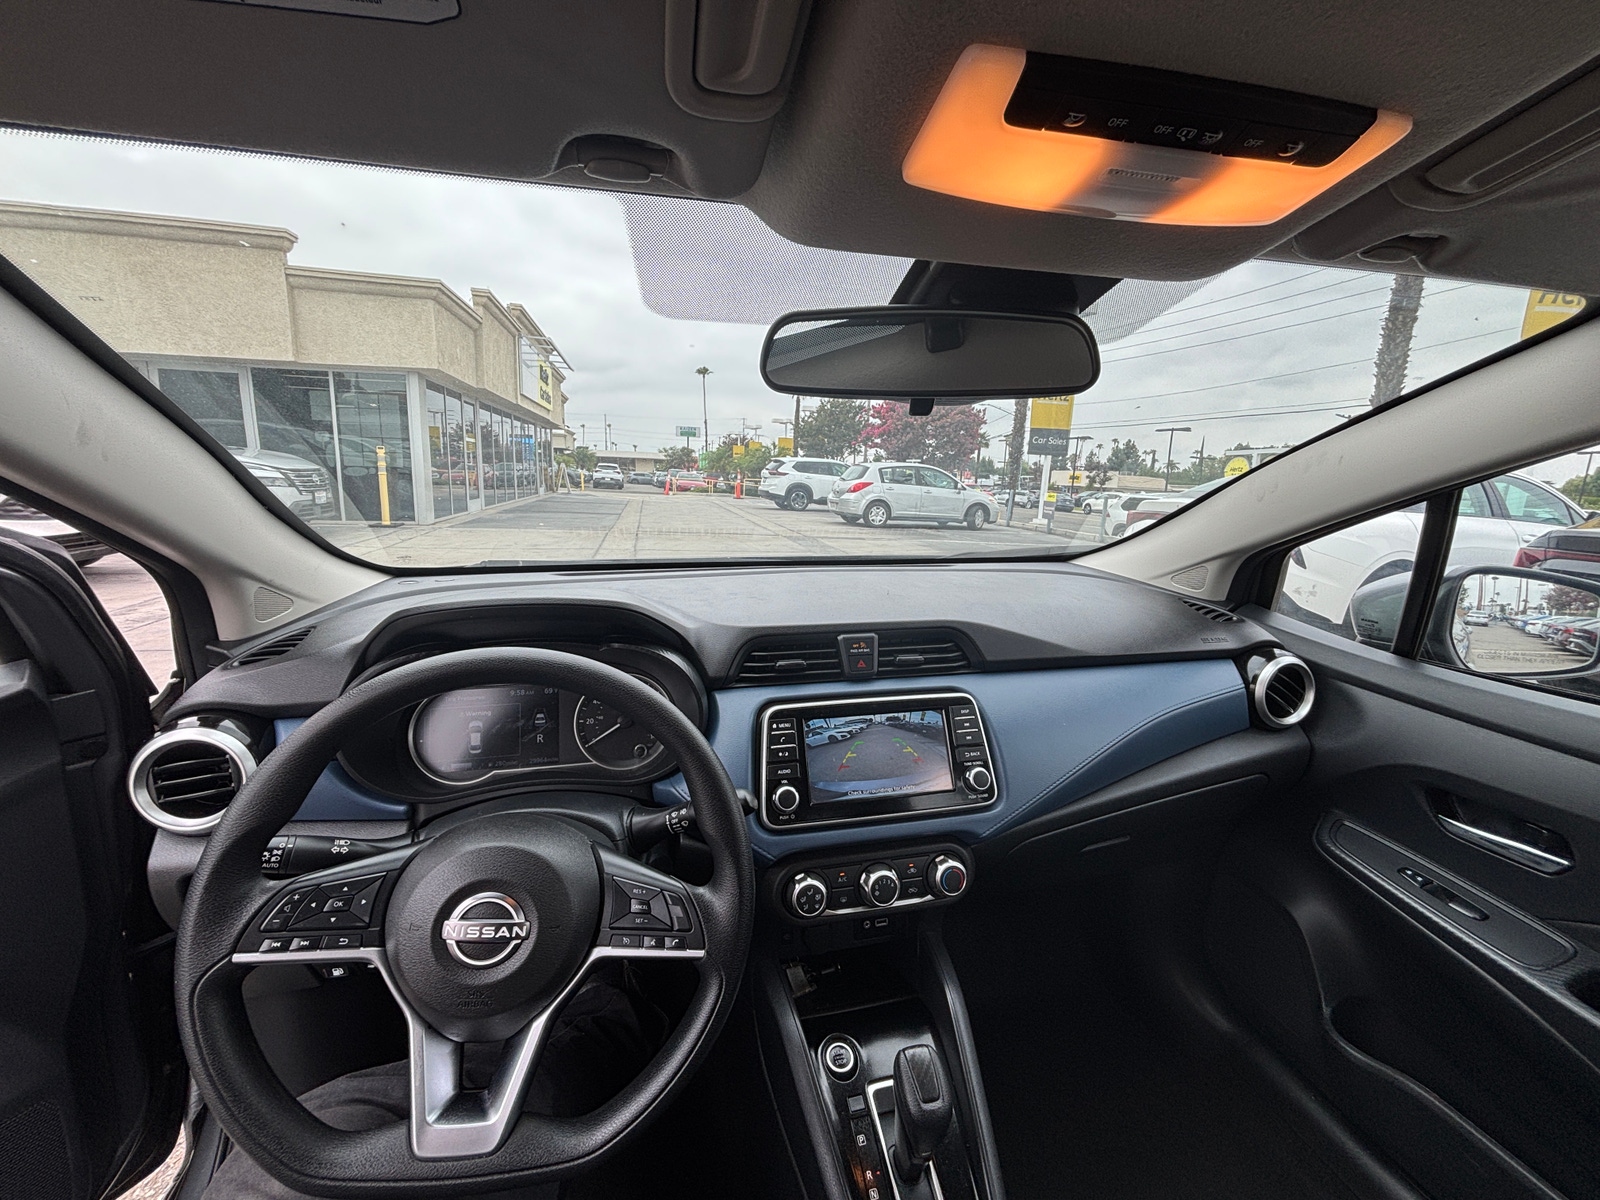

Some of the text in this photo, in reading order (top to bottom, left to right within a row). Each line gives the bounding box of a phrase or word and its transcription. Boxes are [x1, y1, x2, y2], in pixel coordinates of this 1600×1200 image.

[1108, 118, 1129, 128] OFF
[1154, 125, 1174, 135] OFF
[1243, 139, 1264, 148] OFF
[1032, 436, 1067, 445] Car Sales
[537, 735, 544, 743] R
[444, 925, 527, 938] NISSAN
[866, 1170, 873, 1180] R
